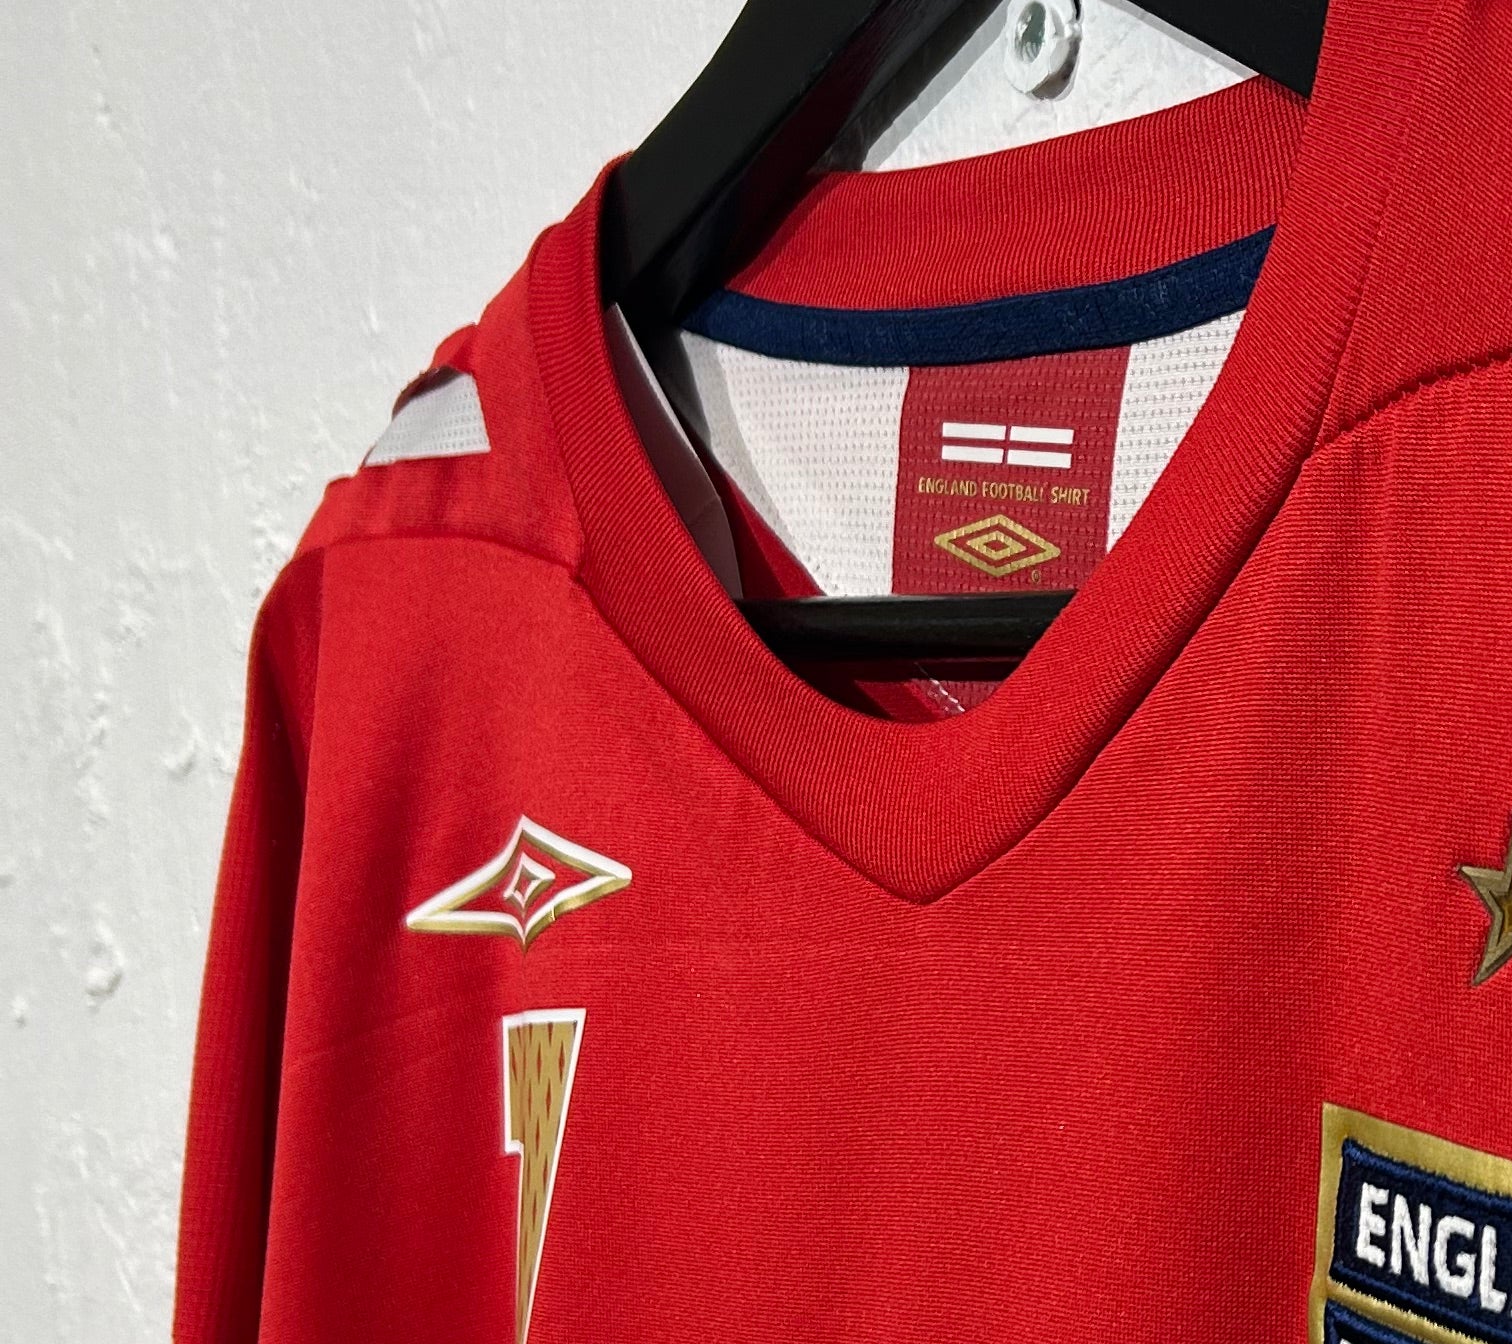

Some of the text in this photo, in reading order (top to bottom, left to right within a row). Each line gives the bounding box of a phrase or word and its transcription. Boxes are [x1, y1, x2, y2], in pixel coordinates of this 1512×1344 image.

[918, 477, 1091, 506] ENGLAND FOOTBALL SHIRT
